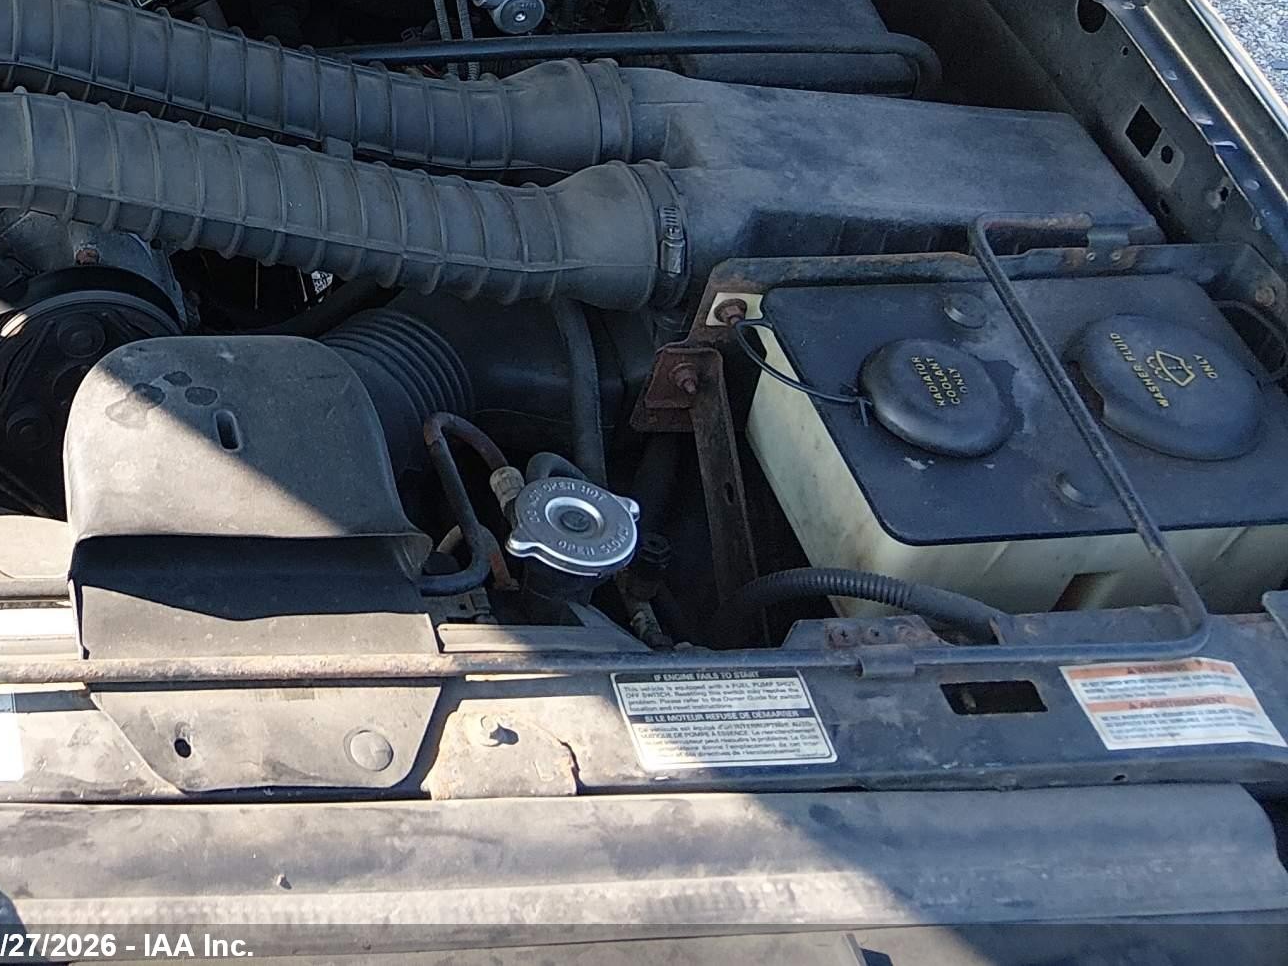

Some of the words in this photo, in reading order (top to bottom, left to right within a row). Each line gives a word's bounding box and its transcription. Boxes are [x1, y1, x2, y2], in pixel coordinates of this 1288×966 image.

[1109, 332, 1137, 363] FLUID
[1192, 353, 1219, 380] ONLY
[911, 355, 945, 407] RADIATOR
[925, 357, 961, 405] COOLANT
[947, 367, 968, 394] ONLY
[1133, 363, 1170, 408] WASHER
[542, 481, 576, 493] OPEN
[580, 484, 608, 502] HOT
[558, 539, 596, 557] OPEN
[653, 674, 662, 682] IF
[662, 673, 696, 682] ENGINE
[695, 672, 720, 681] FAILS
[721, 672, 733, 680] TO
[732, 671, 760, 679] START
[655, 714, 667, 723] LE
[667, 713, 705, 722] MOTEUR
[705, 712, 739, 721] REFUSE
[739, 712, 752, 720] DE
